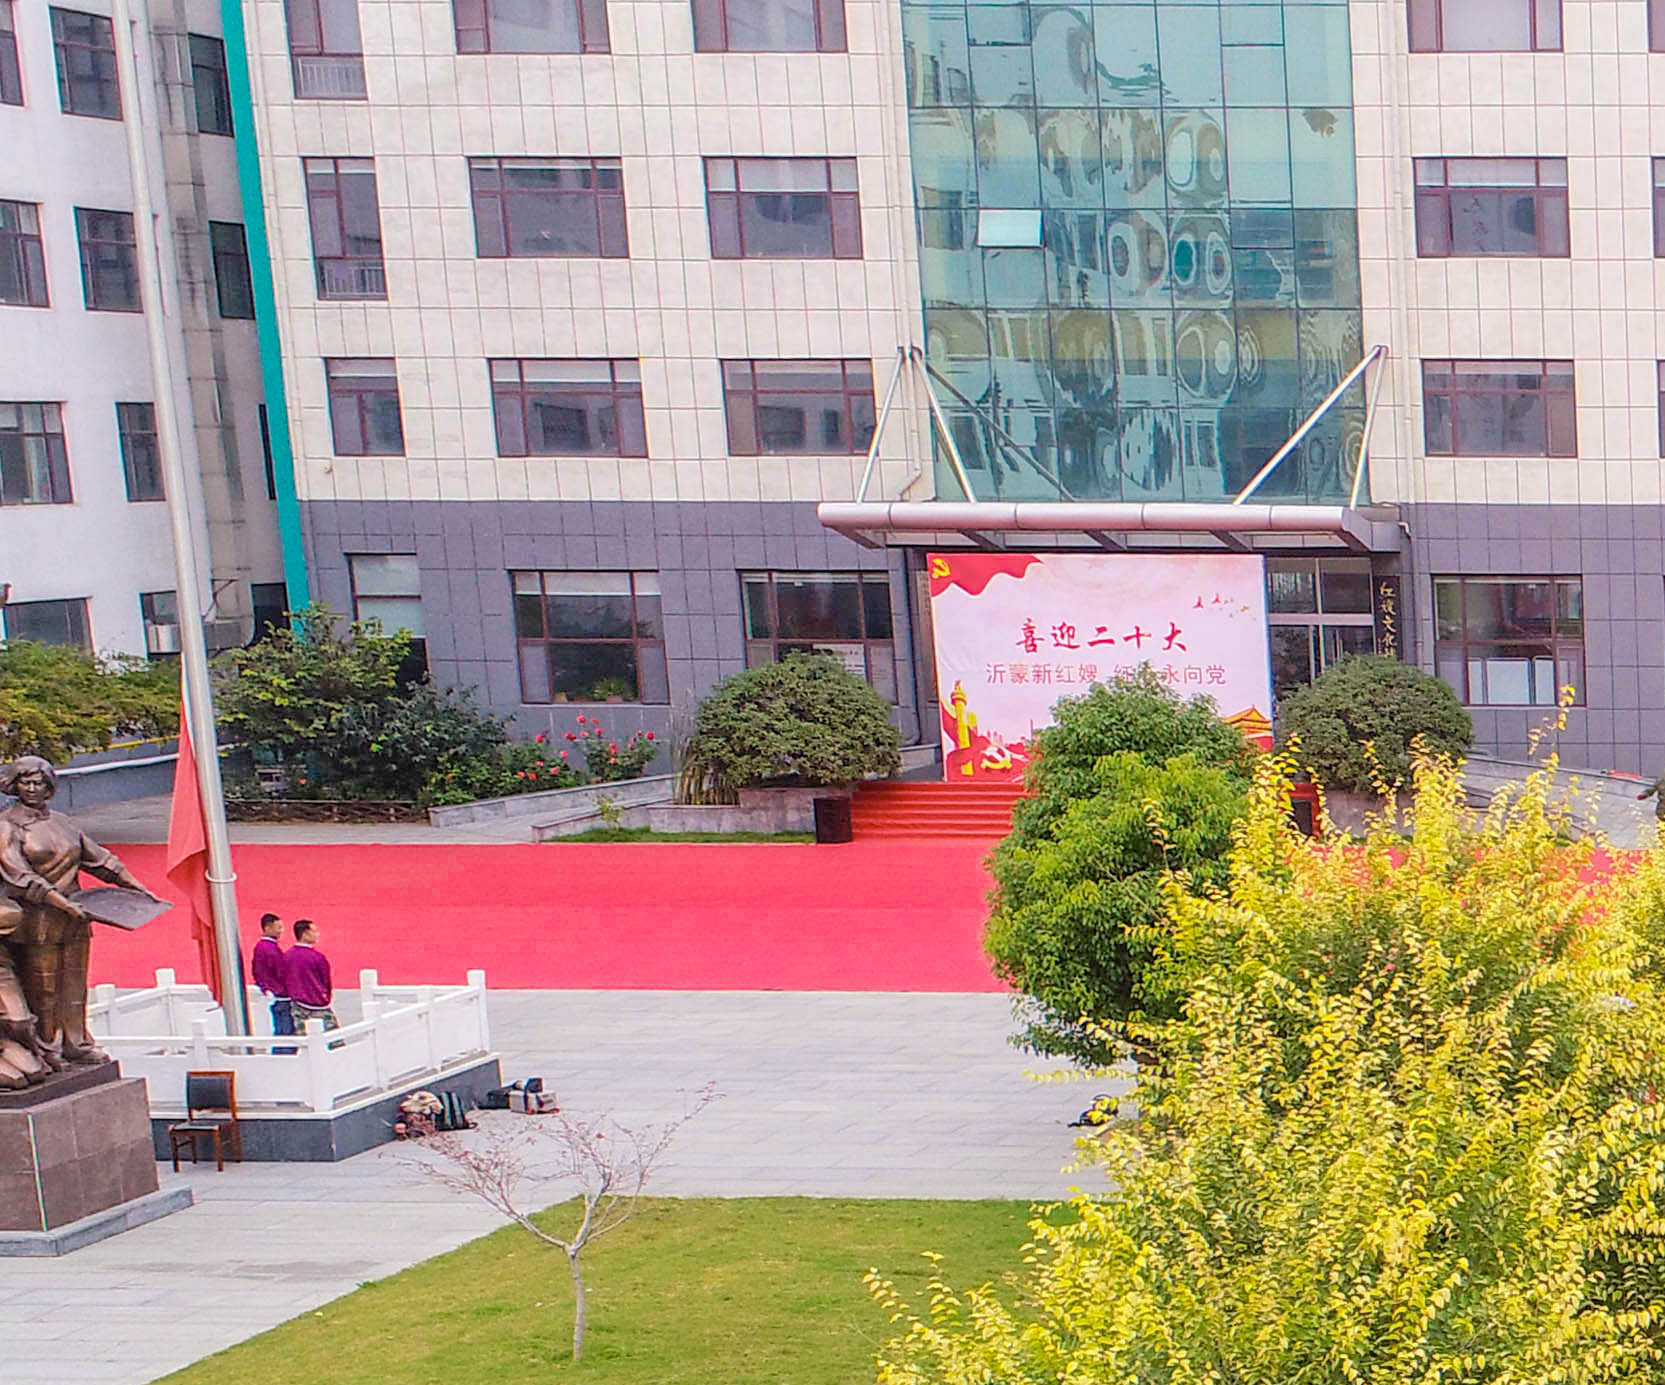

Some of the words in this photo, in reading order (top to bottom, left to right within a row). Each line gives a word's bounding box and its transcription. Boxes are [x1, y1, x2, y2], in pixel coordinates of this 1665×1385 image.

[1015, 618, 1188, 654] 喜迎二十大
[986, 663, 1099, 685] 沂蒙新红嫂
